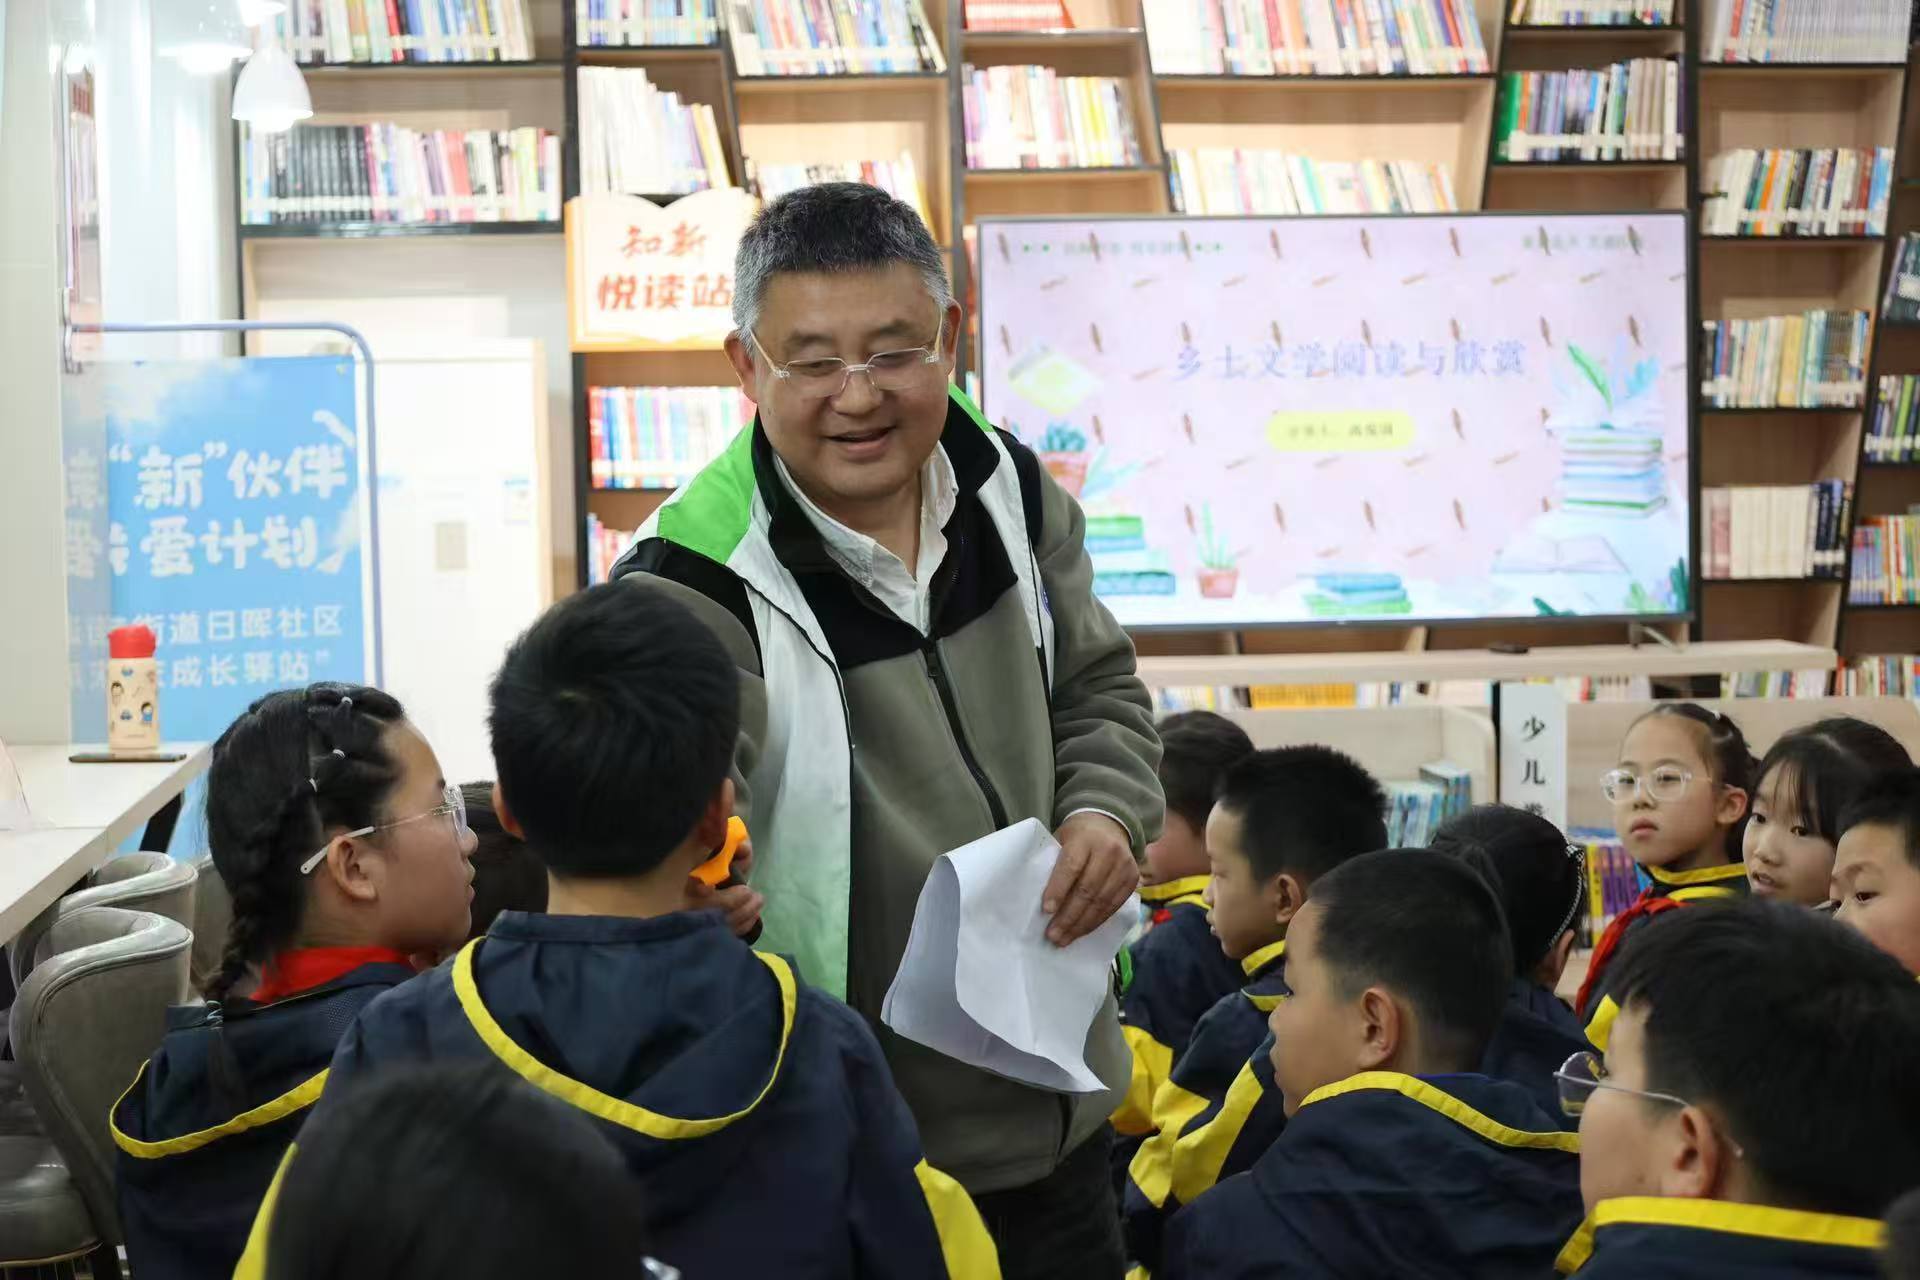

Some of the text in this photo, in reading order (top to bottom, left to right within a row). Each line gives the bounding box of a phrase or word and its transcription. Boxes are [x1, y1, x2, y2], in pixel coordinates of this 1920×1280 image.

[621, 220, 707, 259] 知新
[597, 271, 734, 312] 悦读站
[1174, 340, 1526, 382] 乡土文学阅读与欣赏
[109, 605, 343, 646] 街道日晖社区
